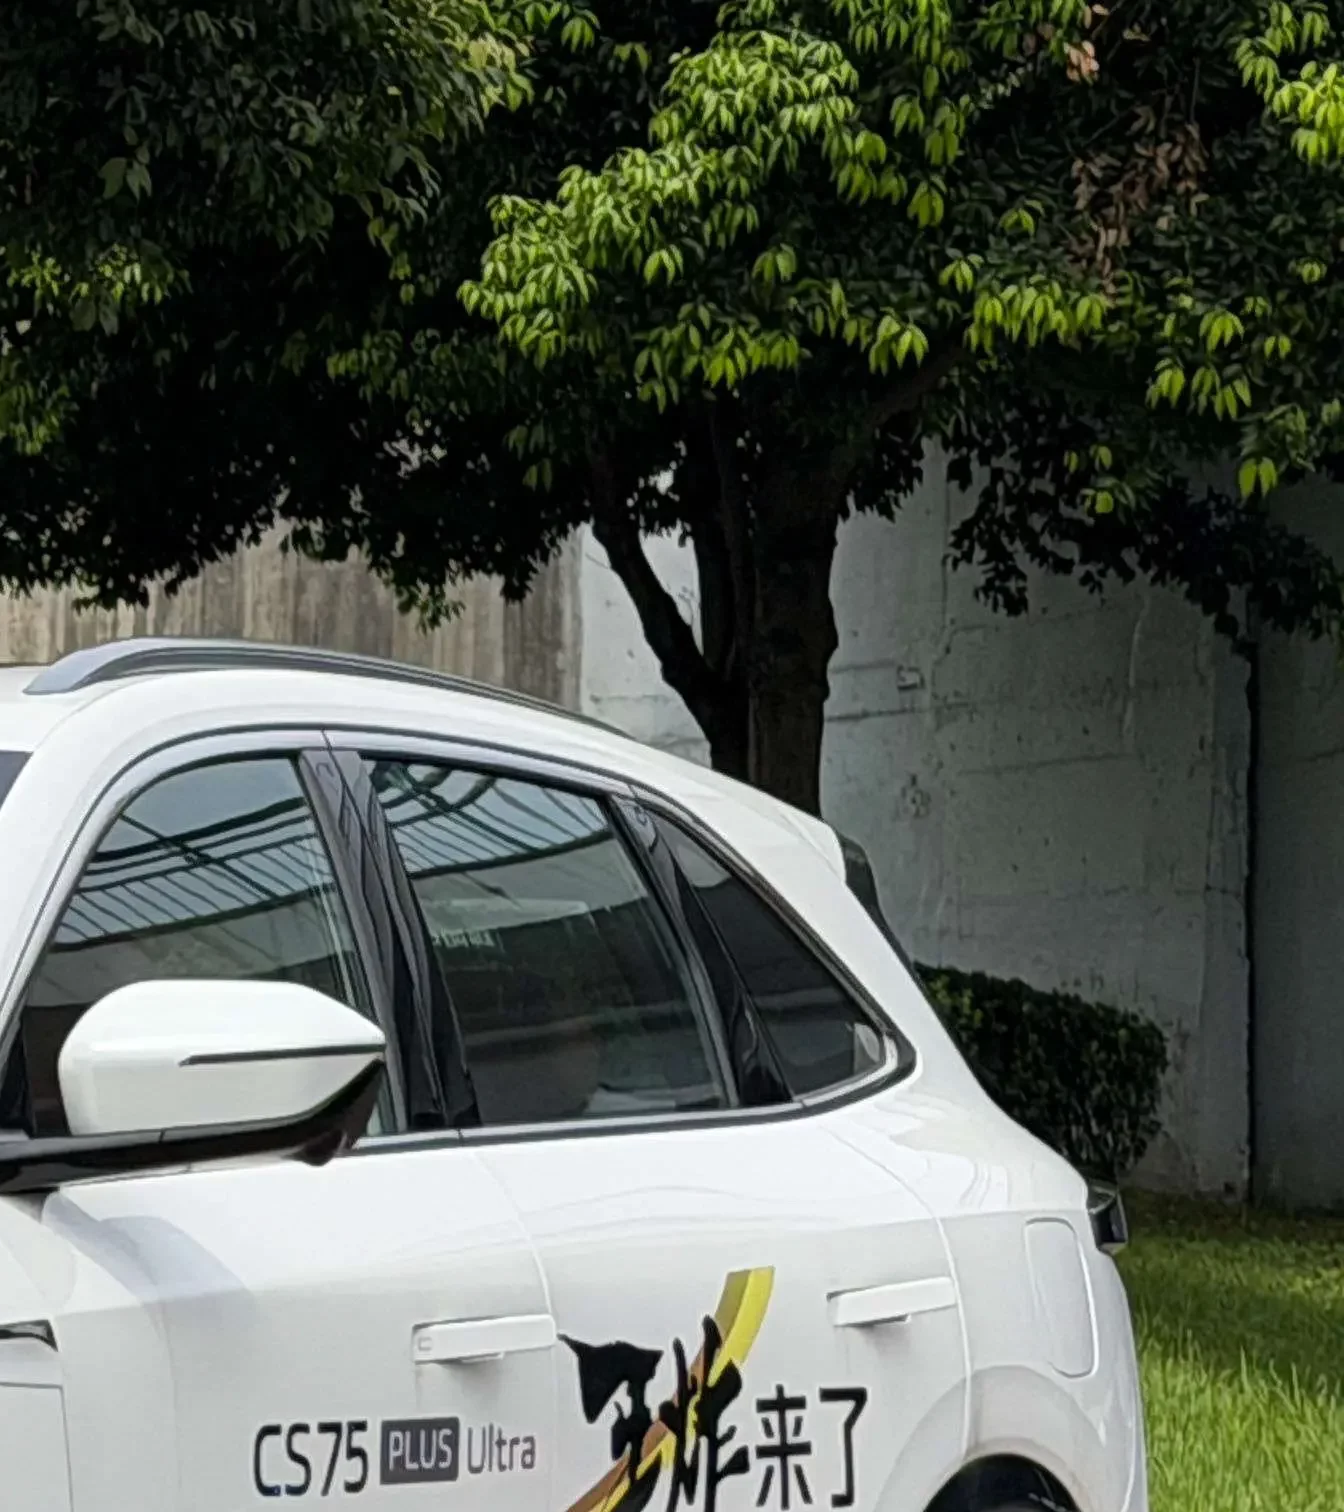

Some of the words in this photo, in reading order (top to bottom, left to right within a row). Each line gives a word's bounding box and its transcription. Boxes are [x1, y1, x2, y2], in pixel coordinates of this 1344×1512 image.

[253, 1420, 369, 1497] CS75
[388, 1427, 453, 1472] PLUS
[466, 1422, 537, 1475] Ultra
